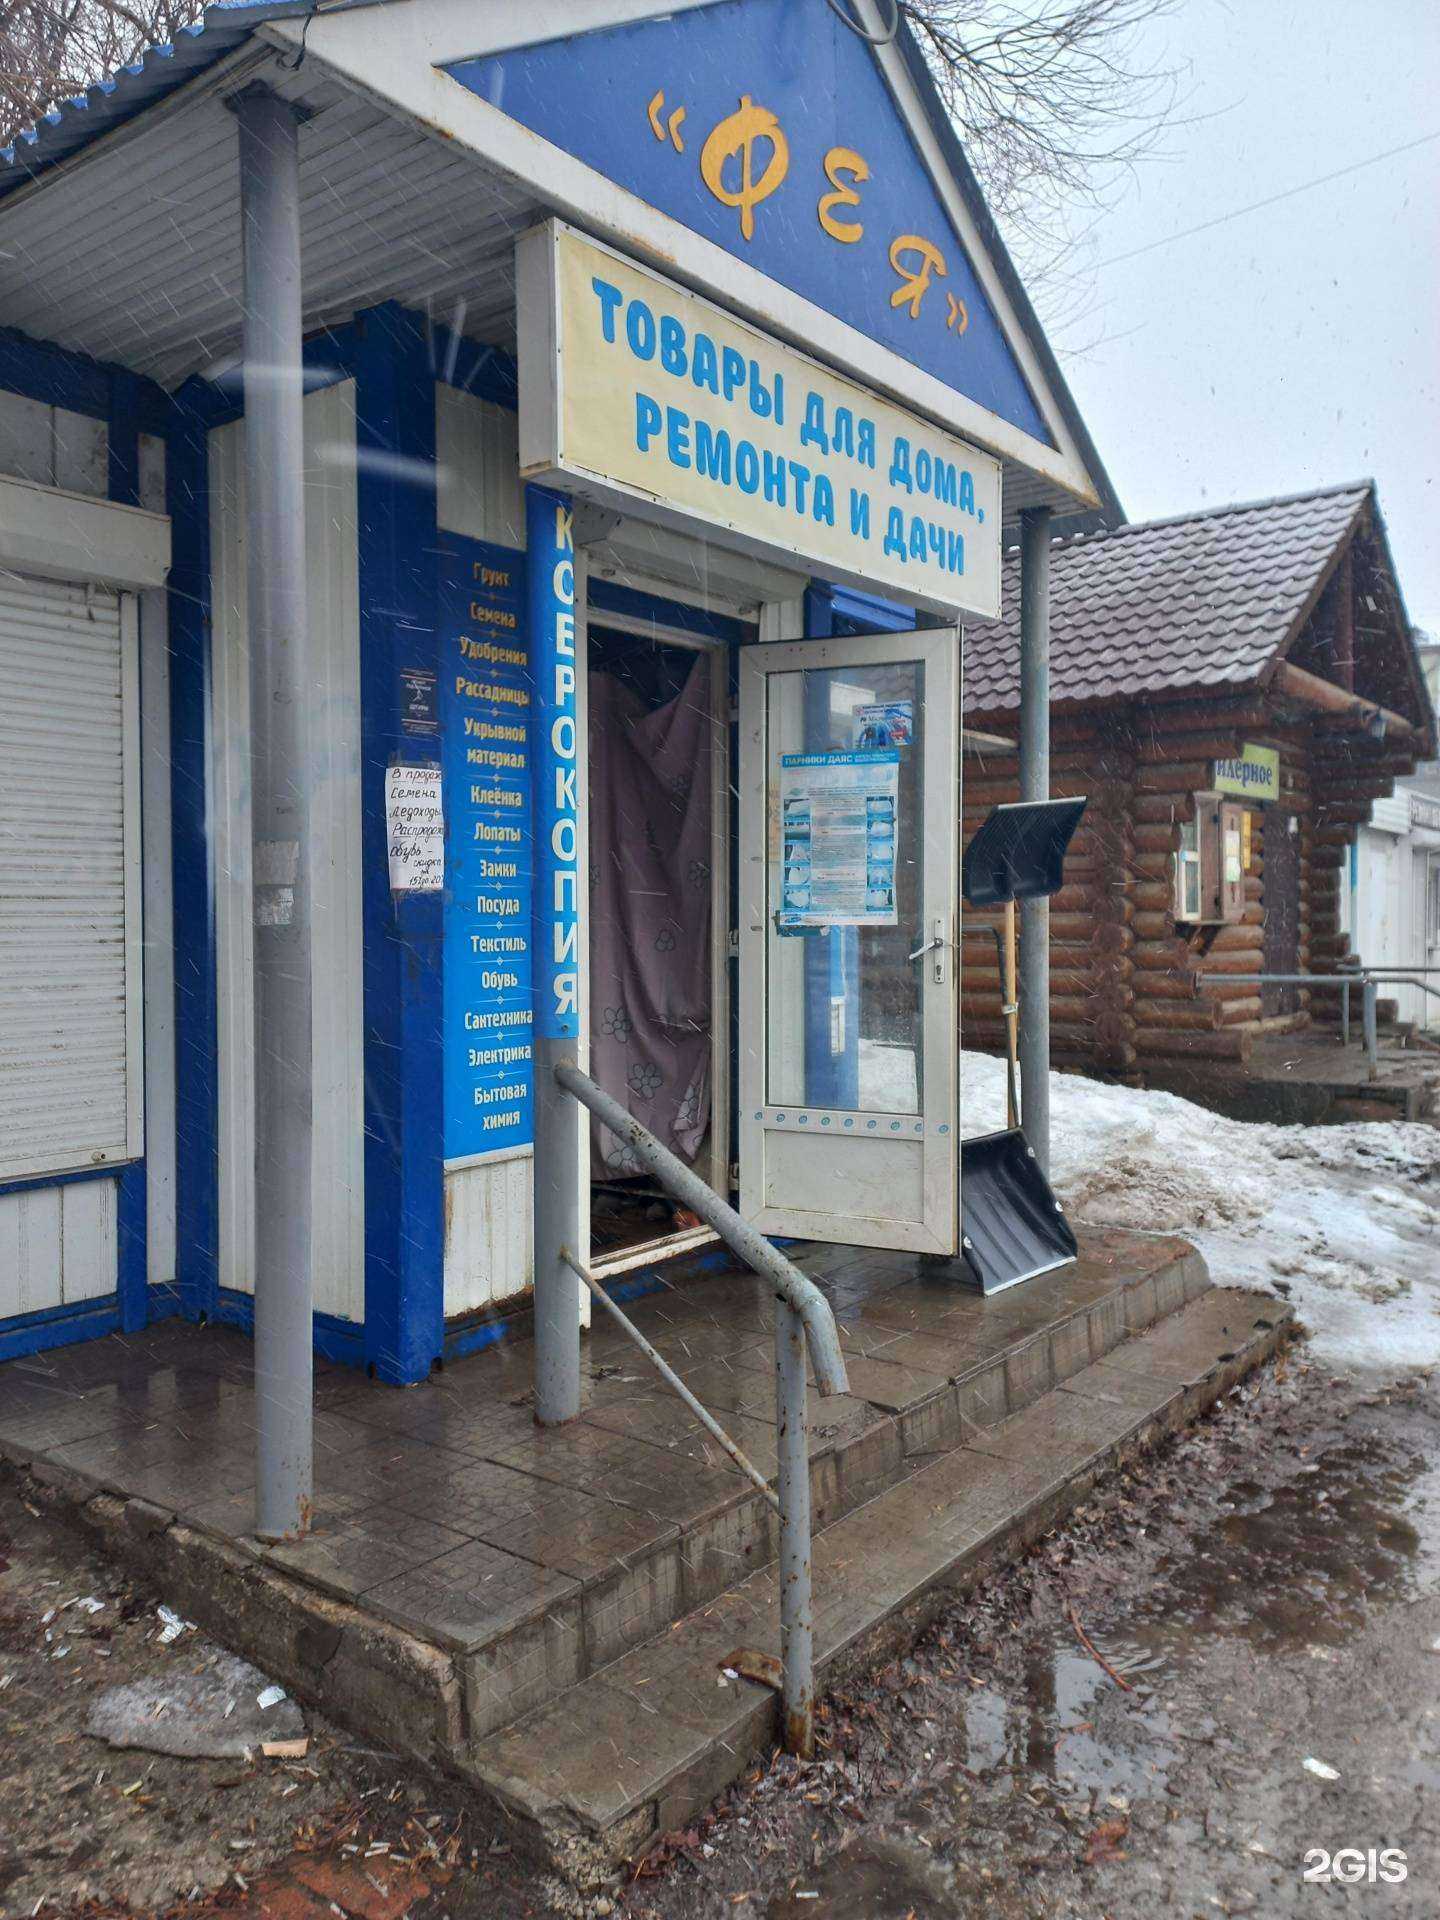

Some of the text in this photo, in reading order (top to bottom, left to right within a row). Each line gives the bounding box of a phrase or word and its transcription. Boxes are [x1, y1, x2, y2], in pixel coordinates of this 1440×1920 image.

[592, 276, 985, 524] ТОВАРЫ ДЛЯ ДОМА,
[635, 392, 965, 577] РЕМОНТА И ДАЧИ
[473, 561, 511, 587] Грунт
[469, 601, 517, 629] Семена
[459, 635, 528, 667] Удобрения
[455, 676, 530, 708] Рассадницы
[463, 715, 527, 743] Укрывной
[466, 746, 526, 769] материал
[551, 505, 578, 1015] КСЕРОКОПИЯ
[390, 787, 437, 799] Семена
[470, 785, 523, 808] Клеёнка
[473, 822, 521, 842] Лопаты
[479, 859, 516, 878] Замки
[476, 895, 520, 915] Посуда
[470, 935, 527, 953] Текстиль
[481, 970, 518, 989] Обувь
[464, 1009, 533, 1031] Сантехника
[468, 1045, 532, 1067] Электрика
[474, 1082, 527, 1105] Бытовая
[482, 1109, 520, 1132] химия
